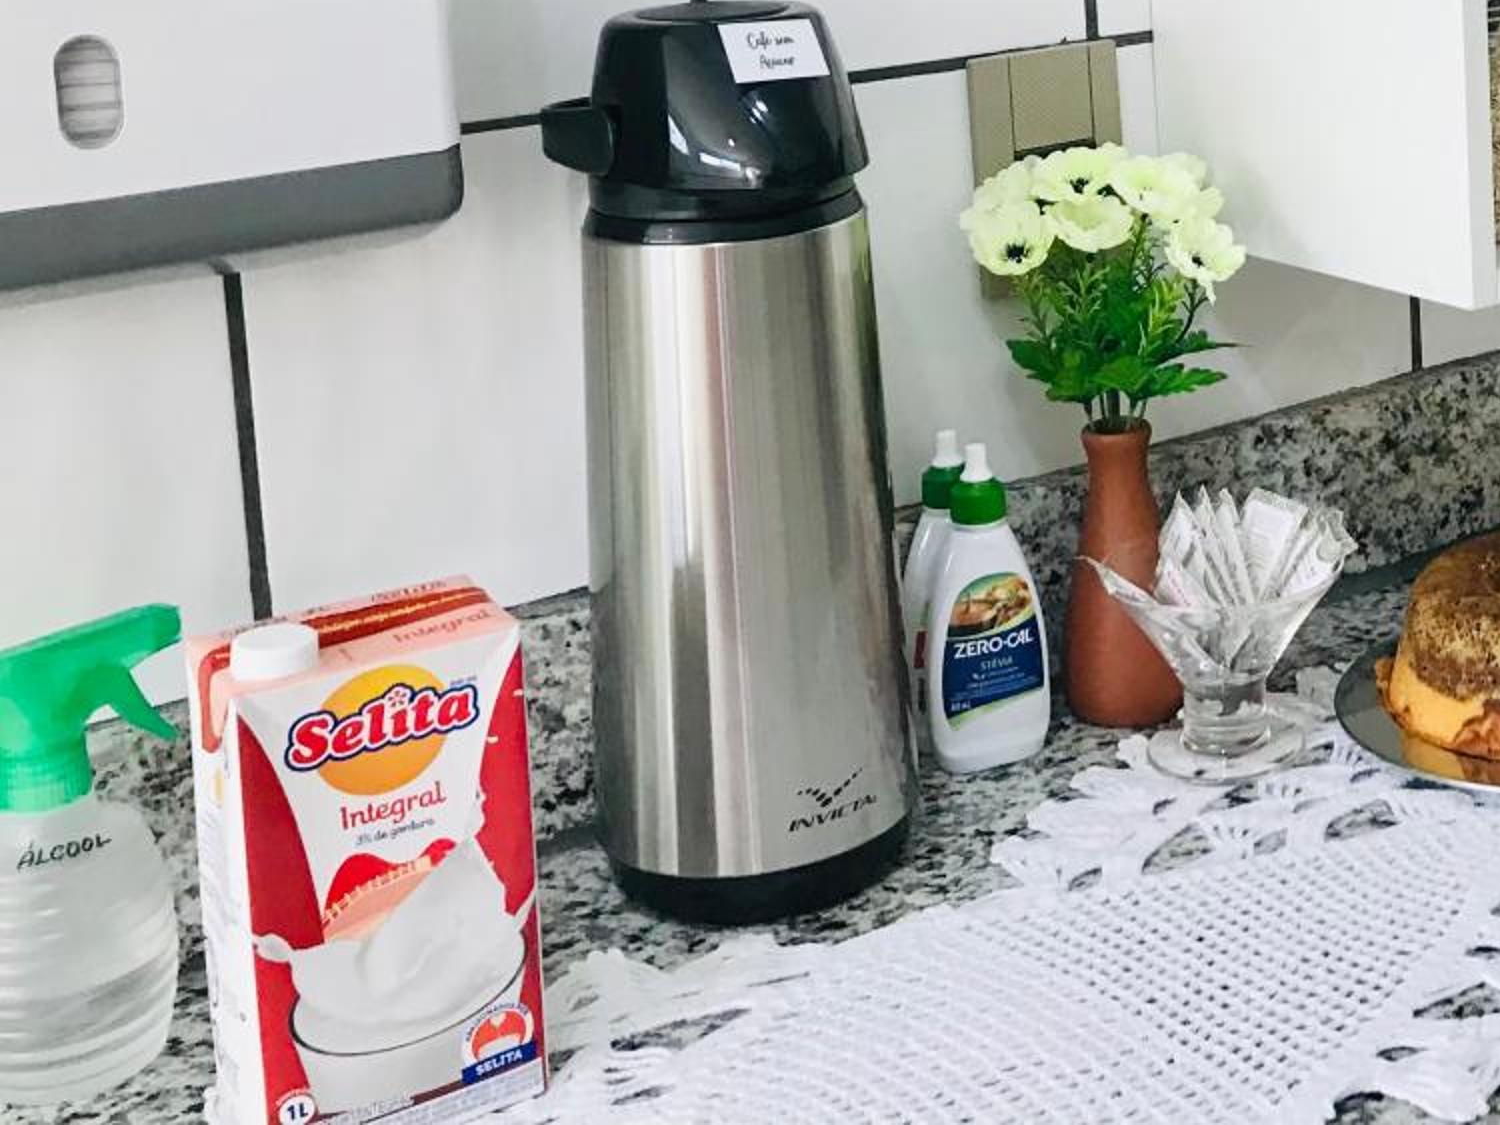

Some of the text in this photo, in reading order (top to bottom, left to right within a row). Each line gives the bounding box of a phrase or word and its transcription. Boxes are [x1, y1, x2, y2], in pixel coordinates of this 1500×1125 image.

[953, 628, 1034, 659] ZERO-CAL
[286, 686, 475, 767] Selita
[340, 780, 448, 831] Integral
[474, 1048, 523, 1076] SELITA
